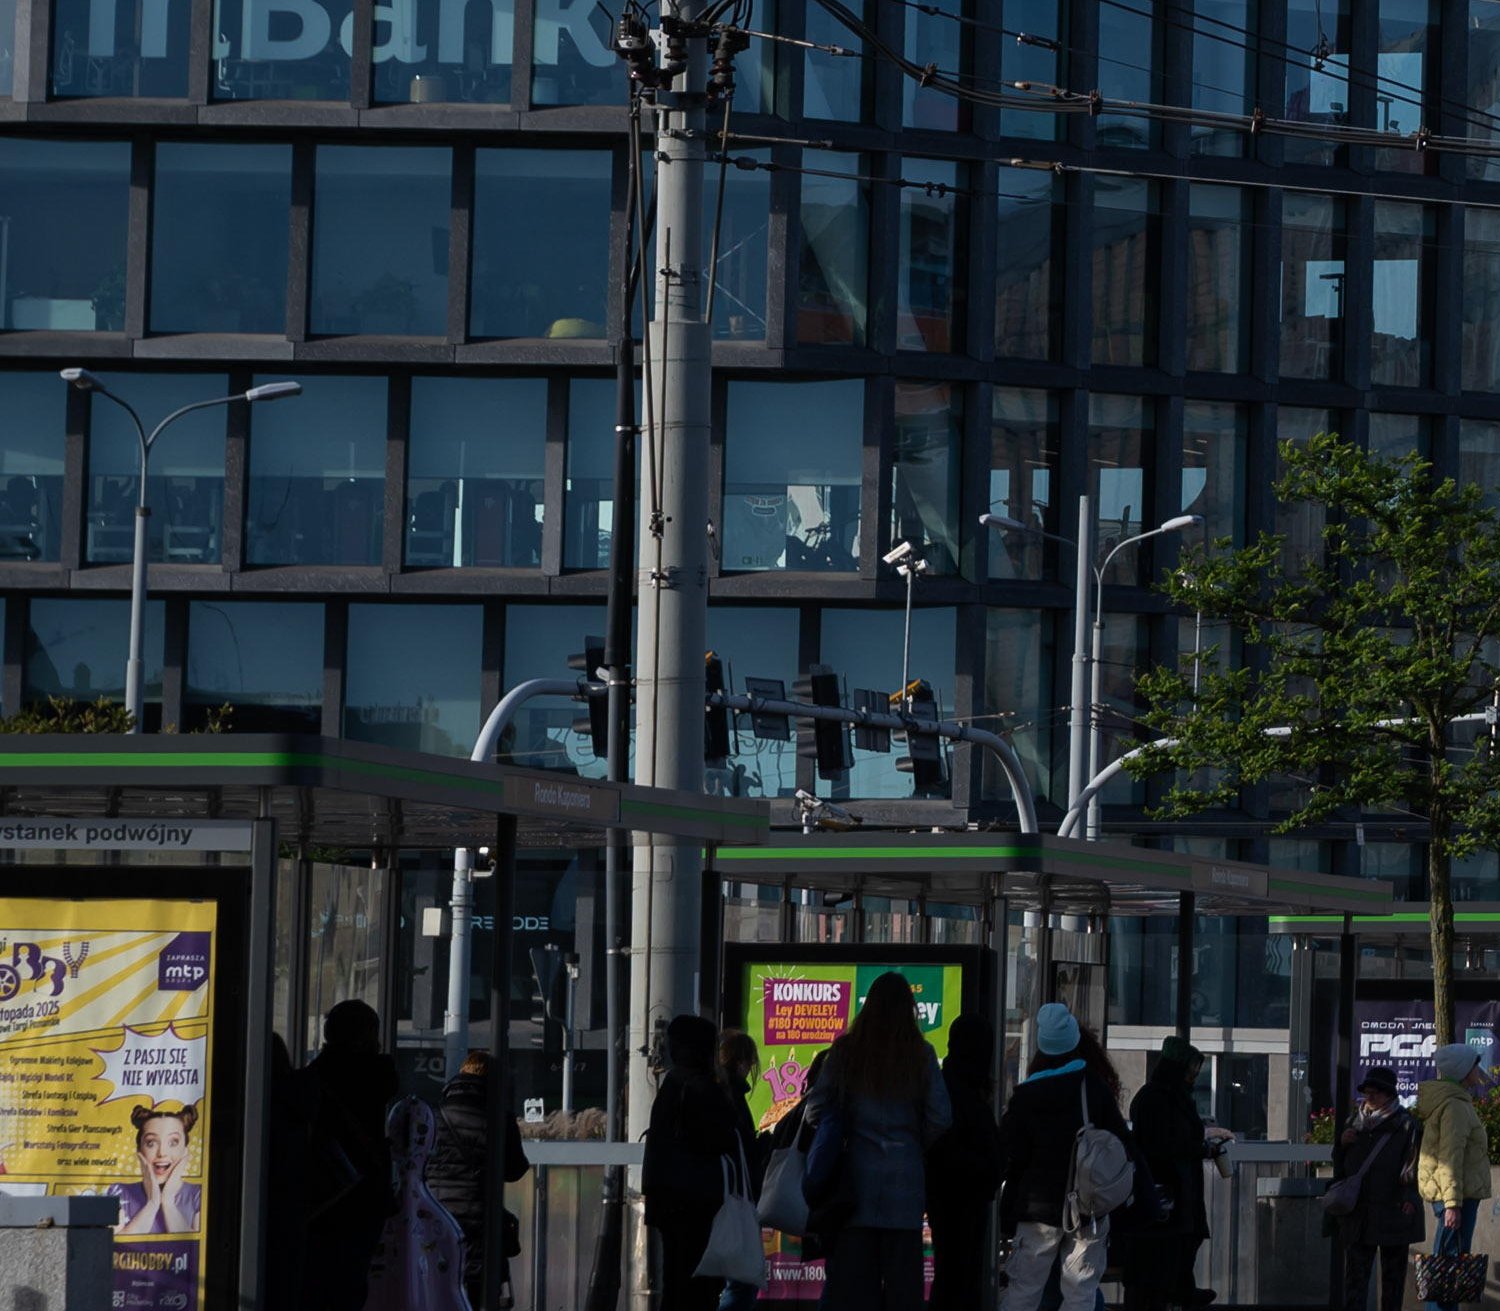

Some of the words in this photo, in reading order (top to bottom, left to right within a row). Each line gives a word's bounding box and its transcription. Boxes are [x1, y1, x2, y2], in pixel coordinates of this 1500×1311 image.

[86, 823, 193, 845] podwójny
[165, 964, 205, 980] mtp
[773, 982, 841, 1002] KONKURS
[36, 1001, 60, 1018] 2025
[776, 1004, 792, 1017] Ley
[794, 1003, 838, 1016] DEVELEY!
[769, 1017, 792, 1030] #180
[793, 1016, 844, 1030] POWODÓW
[1469, 1036, 1494, 1046] mtp
[123, 1049, 131, 1065] Z
[134, 1048, 167, 1065] PASJI
[169, 1047, 188, 1067] SIĘ
[121, 1069, 143, 1086] NIE
[145, 1068, 199, 1086] WYRASTA
